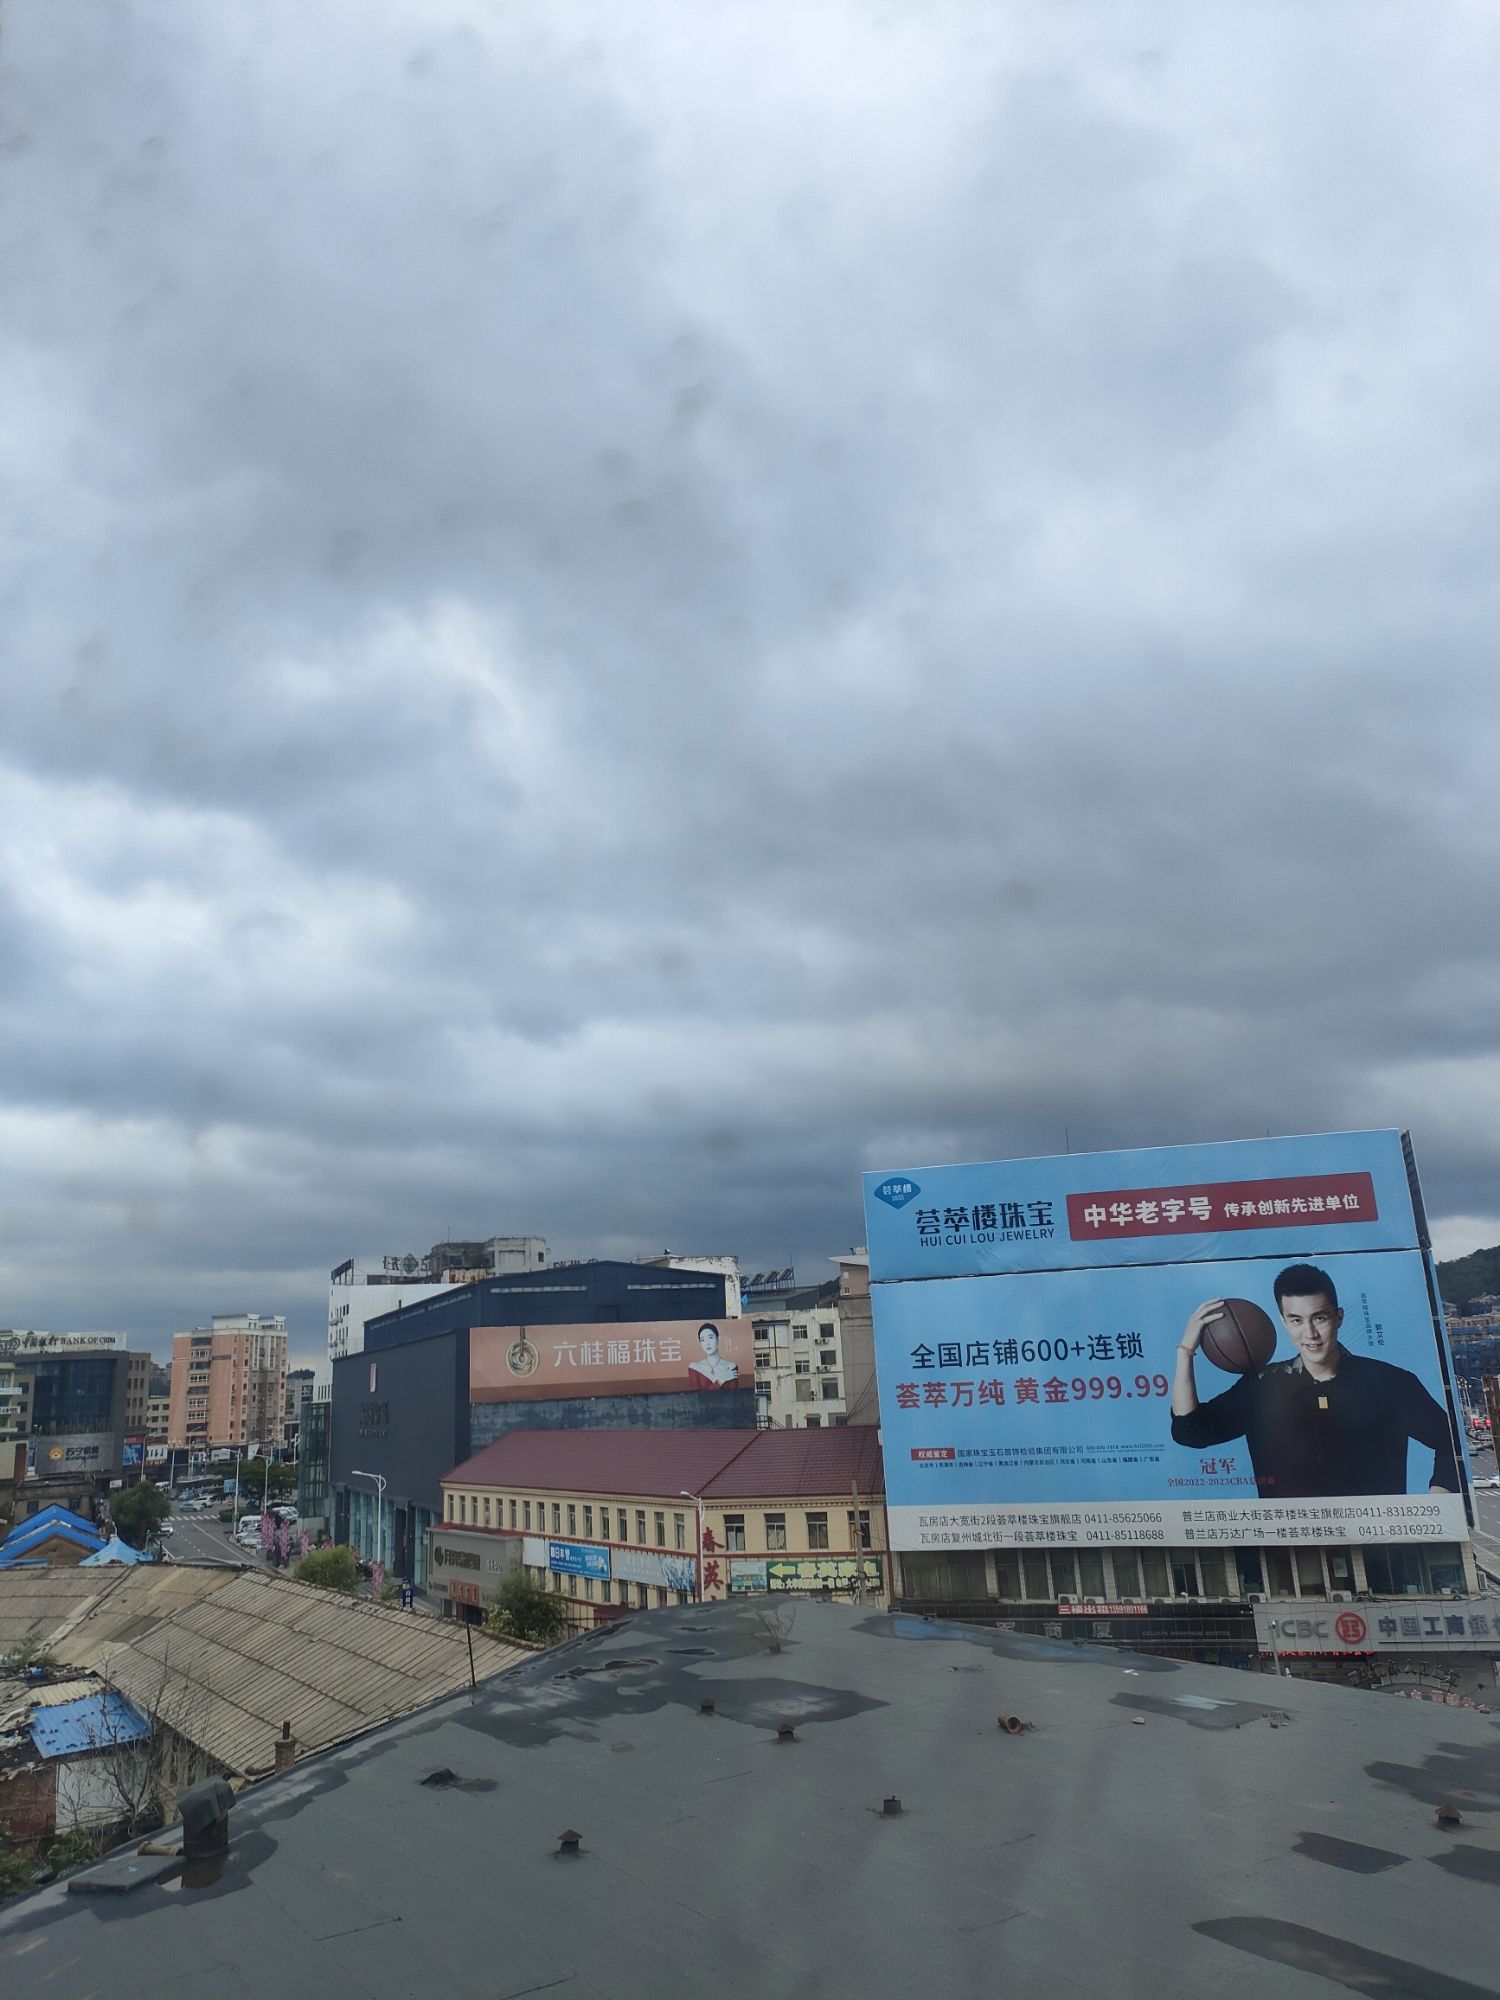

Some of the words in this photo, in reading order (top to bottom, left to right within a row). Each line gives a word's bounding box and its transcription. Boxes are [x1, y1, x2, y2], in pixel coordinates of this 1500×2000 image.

[915, 1200, 1055, 1235] 荟萃楼珠宝
[1083, 1196, 1213, 1228] 中华老字号
[1223, 1193, 1360, 1218] 传承创新先进单位
[920, 1236, 942, 1247] HUI
[945, 1234, 966, 1246] CUI
[970, 1232, 995, 1244] LOU
[999, 1228, 1055, 1242] JEWELRY
[60, 1336, 87, 1345] BANK
[87, 1336, 98, 1344] OF
[910, 1331, 1145, 1369] 全国店铺600+连锁
[553, 1337, 682, 1368] 六桂福珠宝
[895, 1378, 1005, 1409] 荟萃万纯
[1013, 1374, 1170, 1405] 黄金999.99
[1200, 1457, 1237, 1475] 冠军
[1084, 1512, 1163, 1525] 0411-85625066
[1086, 1529, 1165, 1542] 0411-85118688
[1358, 1524, 1444, 1538] 0411-83169222
[702, 1526, 725, 1600] 春英
[1274, 1619, 1329, 1638] ICBC
